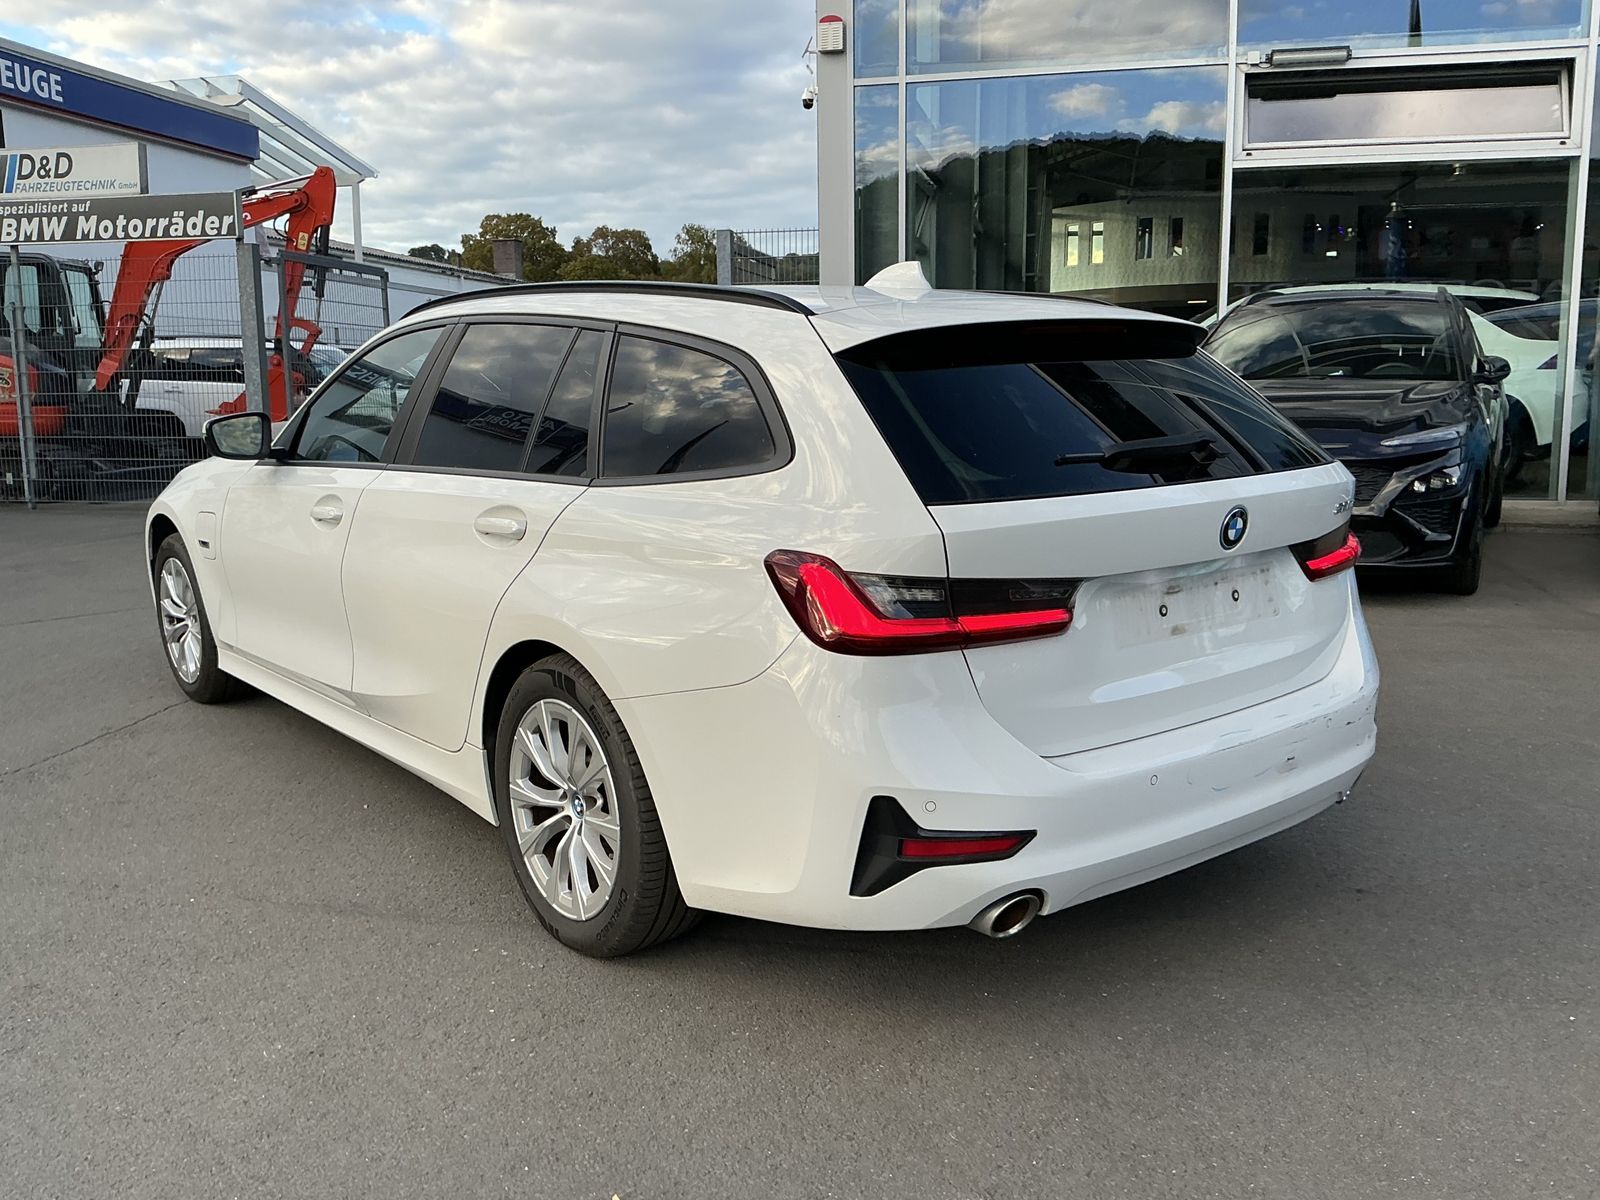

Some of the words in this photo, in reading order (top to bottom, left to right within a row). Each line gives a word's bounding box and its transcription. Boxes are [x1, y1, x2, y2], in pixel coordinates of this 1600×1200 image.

[0, 58, 63, 102] EUGE
[17, 152, 73, 180] D&D
[14, 179, 117, 193] FAHRZEUGTECHNIK
[118, 181, 138, 190] GmbH
[0, 202, 68, 216] spezialisiert
[71, 201, 91, 212] auf
[1, 216, 68, 242] BMW
[75, 210, 234, 240] Motorräder
